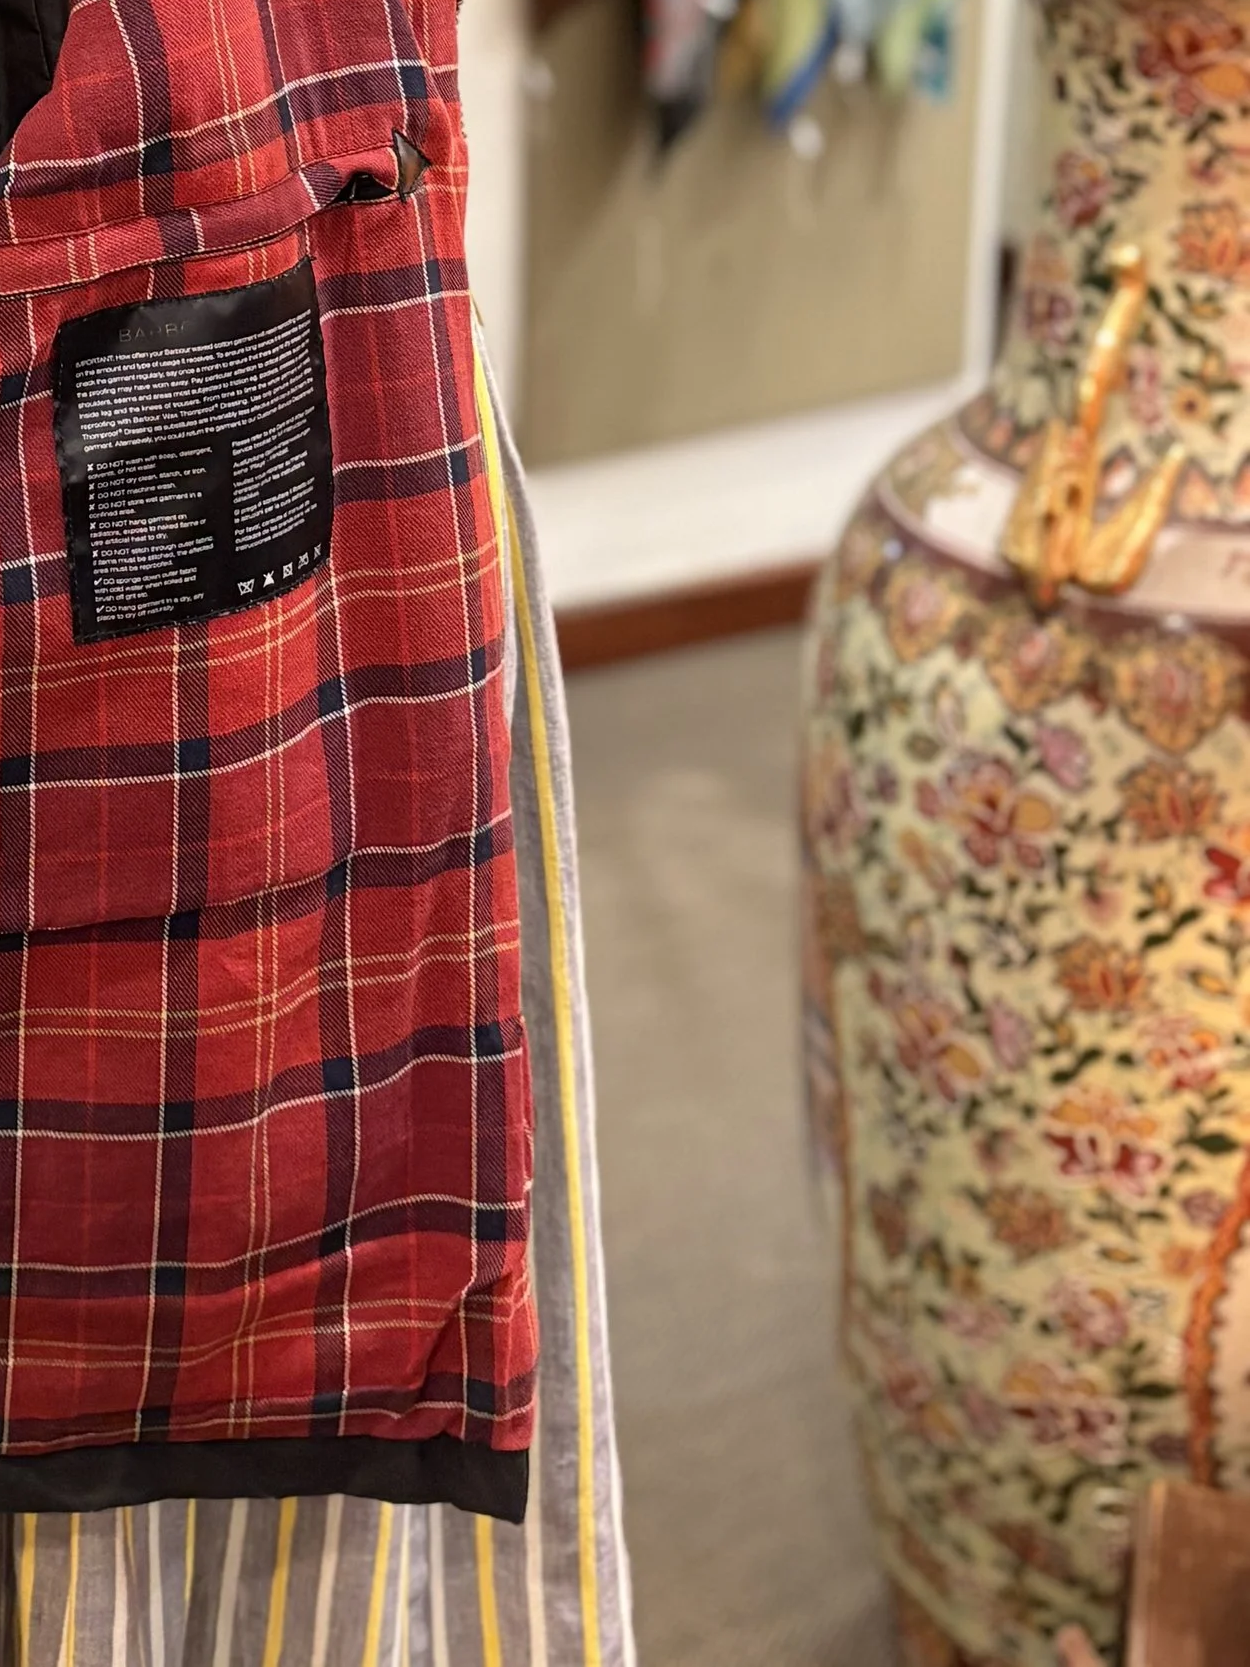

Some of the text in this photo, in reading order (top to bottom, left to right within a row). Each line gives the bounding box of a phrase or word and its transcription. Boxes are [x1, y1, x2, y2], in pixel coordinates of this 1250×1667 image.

[109, 460, 125, 468] NOT
[110, 478, 125, 486] NOT
[110, 489, 125, 497] NOT
[111, 500, 126, 508] NOT
